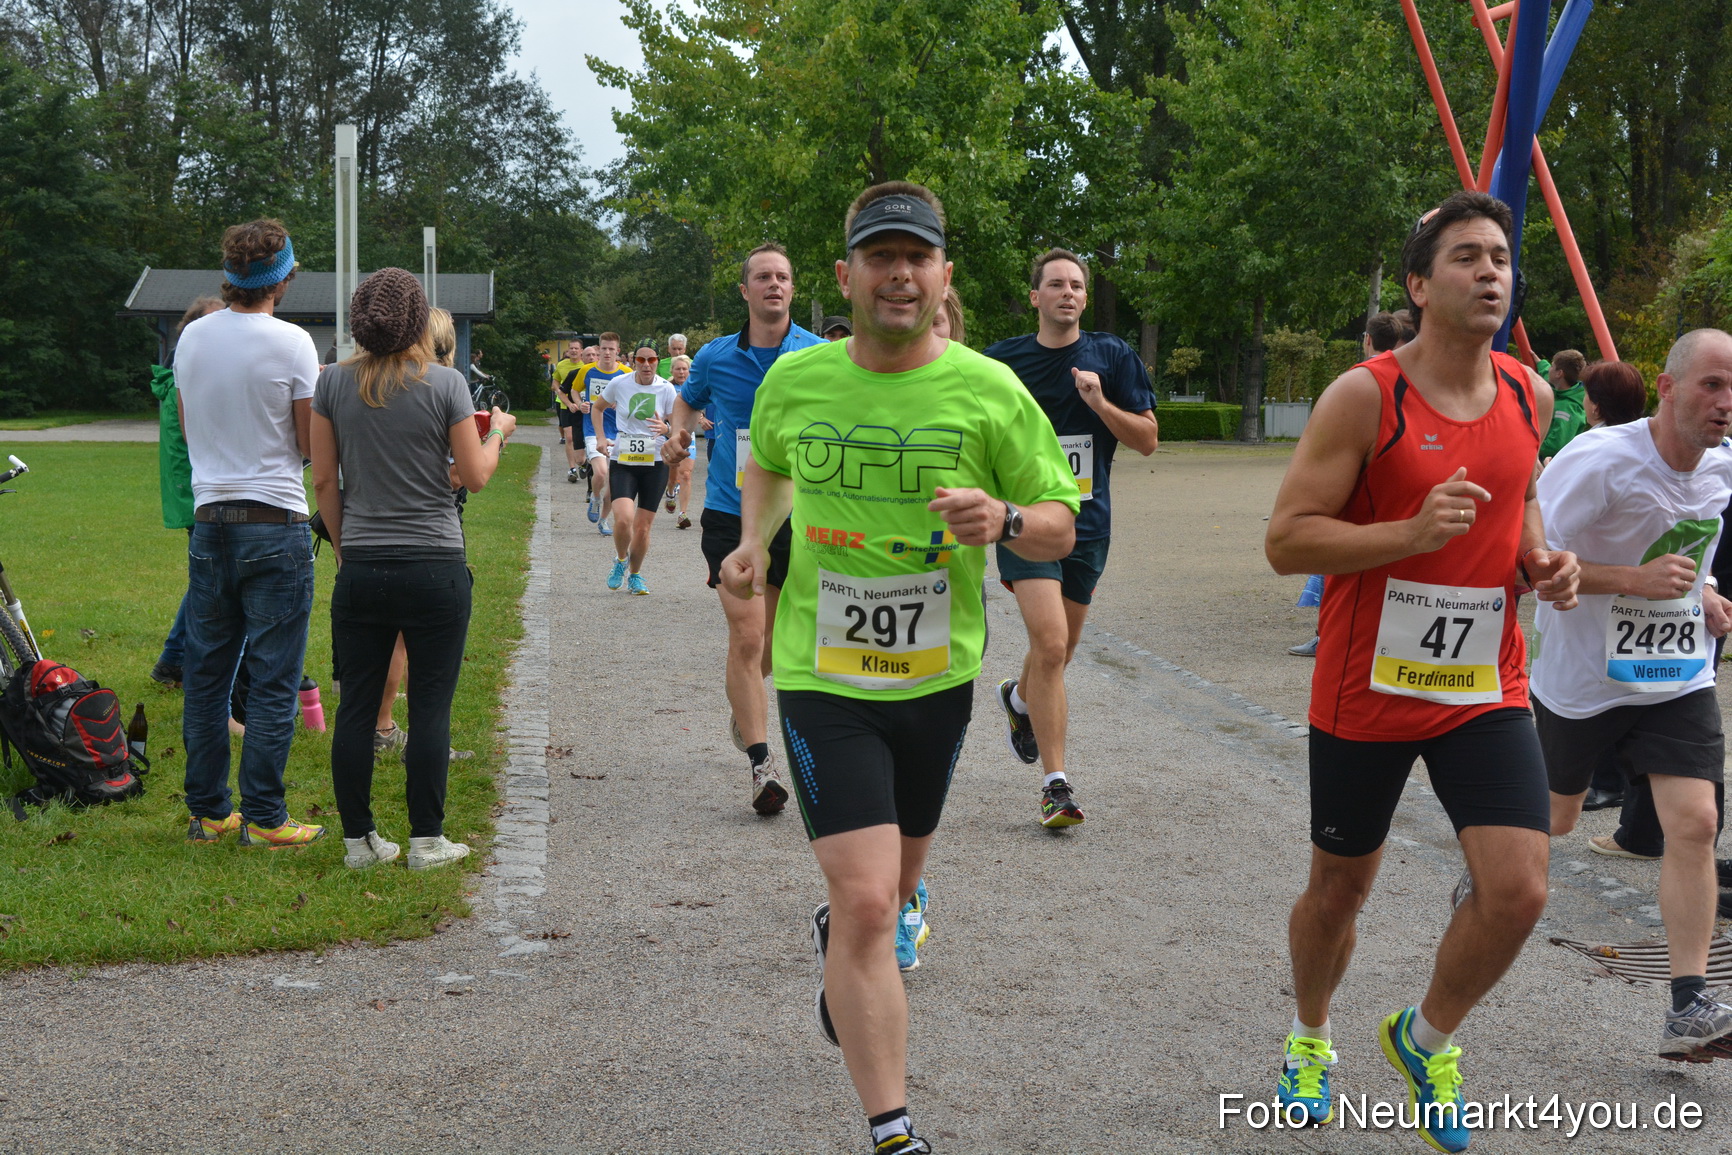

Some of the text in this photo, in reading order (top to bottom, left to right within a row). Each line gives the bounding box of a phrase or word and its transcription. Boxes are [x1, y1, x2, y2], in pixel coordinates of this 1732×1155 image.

[629, 439, 645, 453] 53
[826, 489, 841, 498] und
[842, 491, 933, 505] Automatisierungstechnik
[208, 509, 248, 522] PMA
[805, 524, 865, 550] MERZ
[891, 541, 960, 554] Bretschneider
[821, 579, 928, 600] PARTL Neumarkt
[1387, 590, 1490, 611] PARTL Neumarkt
[1611, 605, 1691, 618] PARTL Neumarkt
[844, 602, 925, 648] 297
[1419, 616, 1475, 659] 47
[1616, 620, 1696, 655] 2428
[861, 655, 910, 675] Klaus
[1633, 664, 1682, 679] Werner
[1396, 665, 1475, 688] Ferdinand
